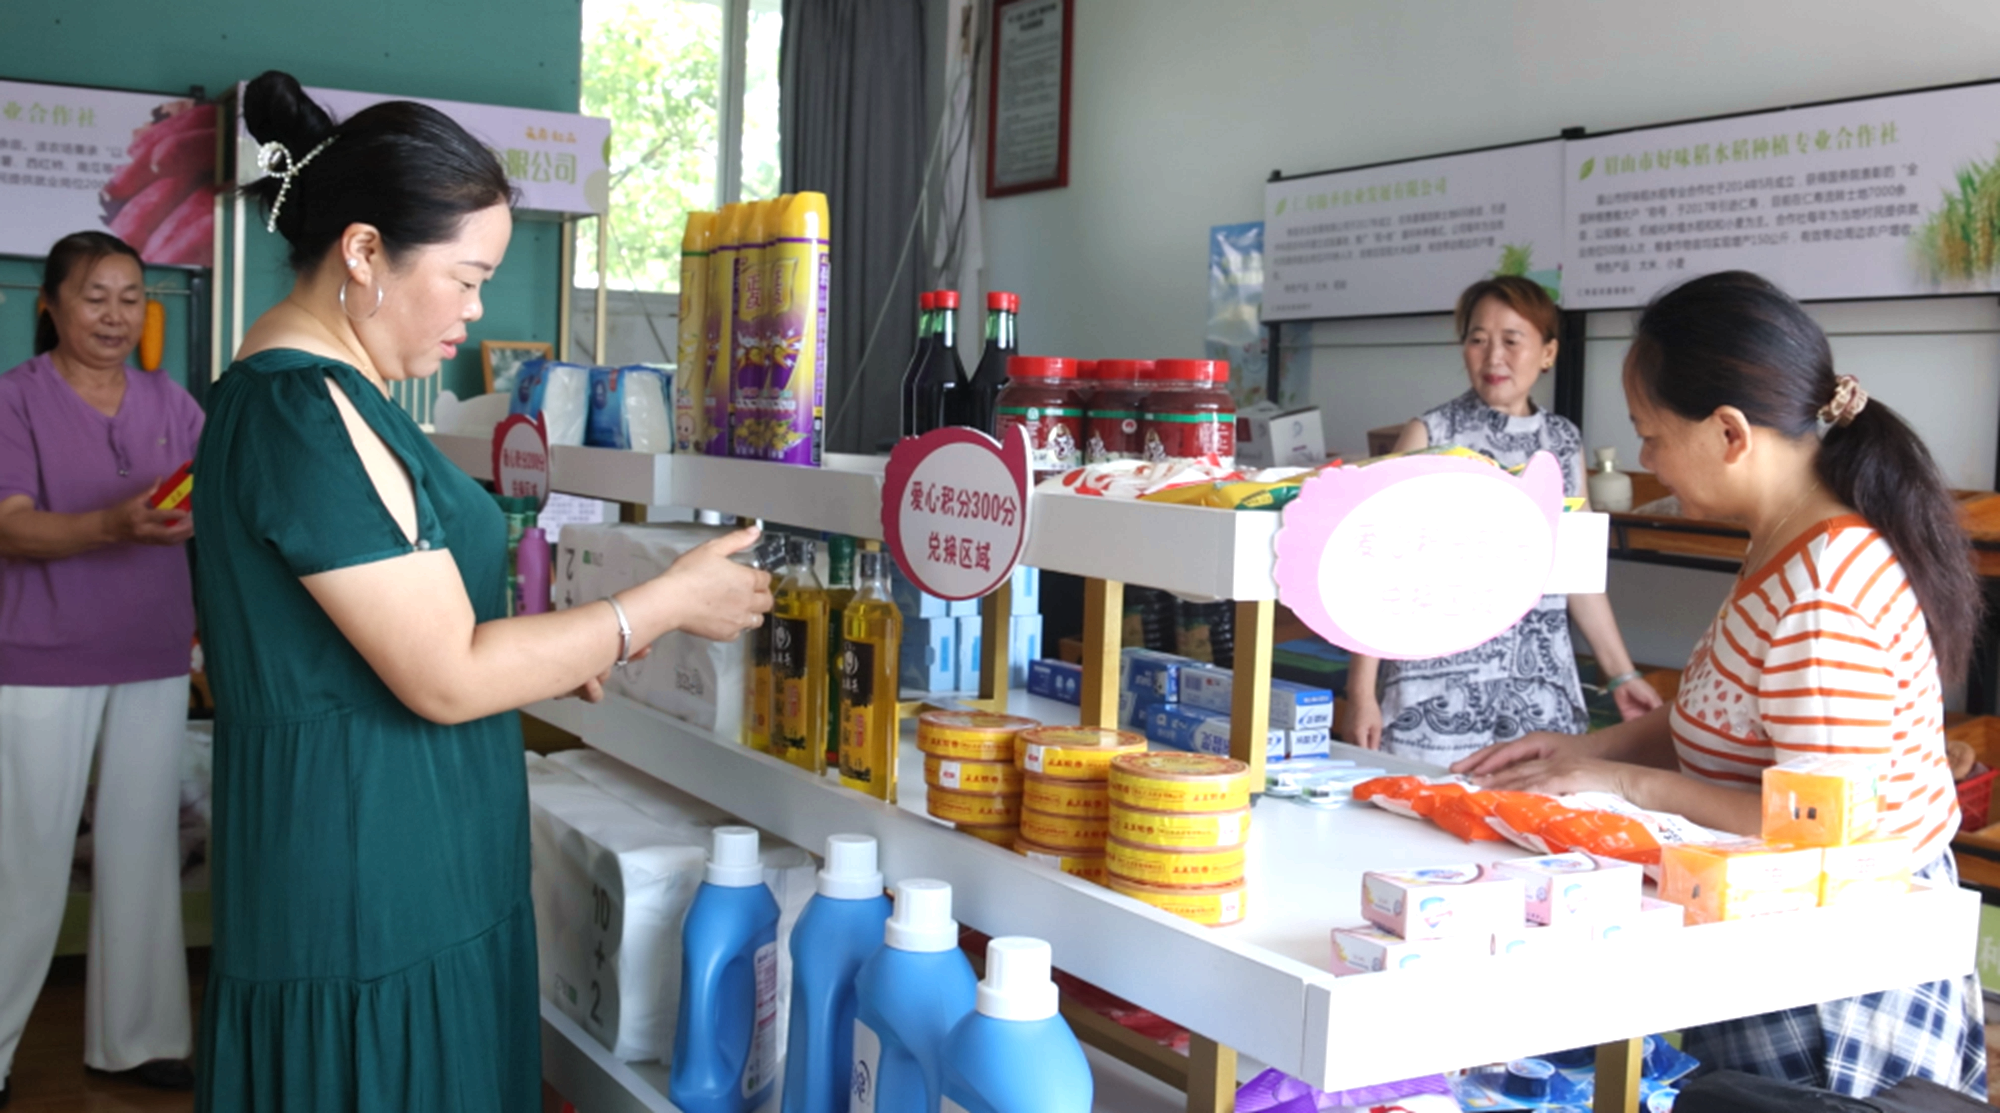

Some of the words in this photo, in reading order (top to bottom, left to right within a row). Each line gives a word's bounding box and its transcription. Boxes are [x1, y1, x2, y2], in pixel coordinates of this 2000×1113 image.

[3, 101, 97, 128] 业合作社
[911, 481, 1017, 526] 爱心积分300分
[928, 531, 991, 572] 兑换区域
